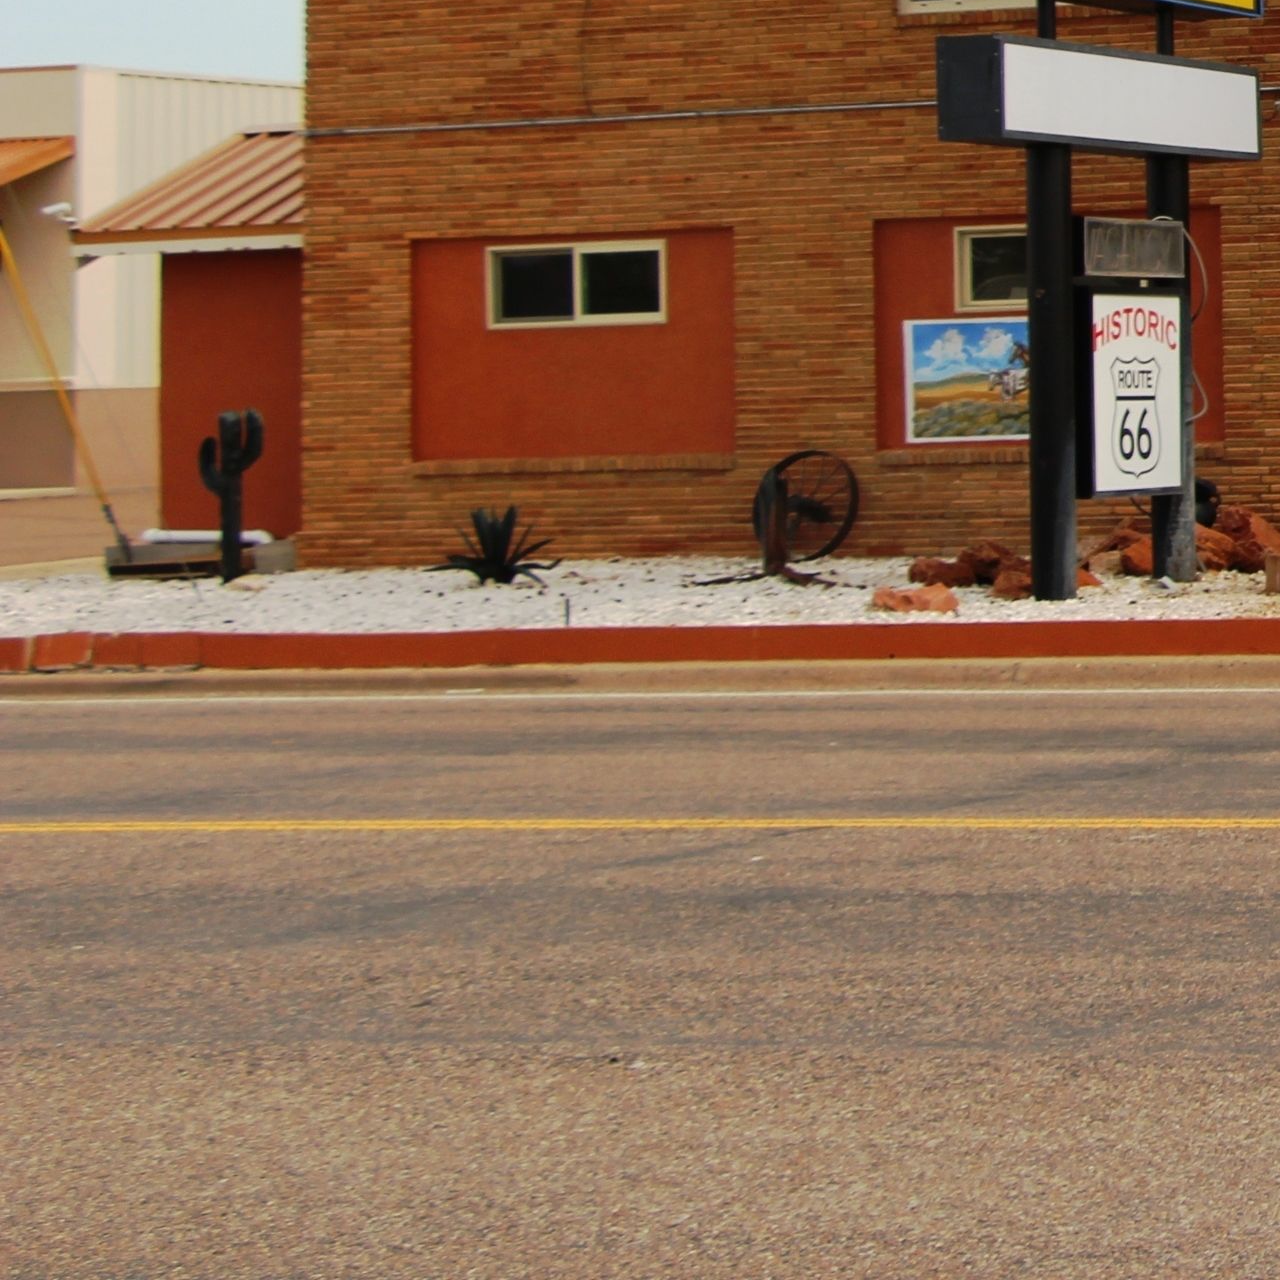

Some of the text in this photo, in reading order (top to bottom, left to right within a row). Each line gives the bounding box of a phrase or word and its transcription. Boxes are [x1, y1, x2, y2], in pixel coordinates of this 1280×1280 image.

[1093, 307, 1178, 353] HISTORIC
[1118, 370, 1153, 389] ROUTE
[1119, 408, 1152, 461] 66
